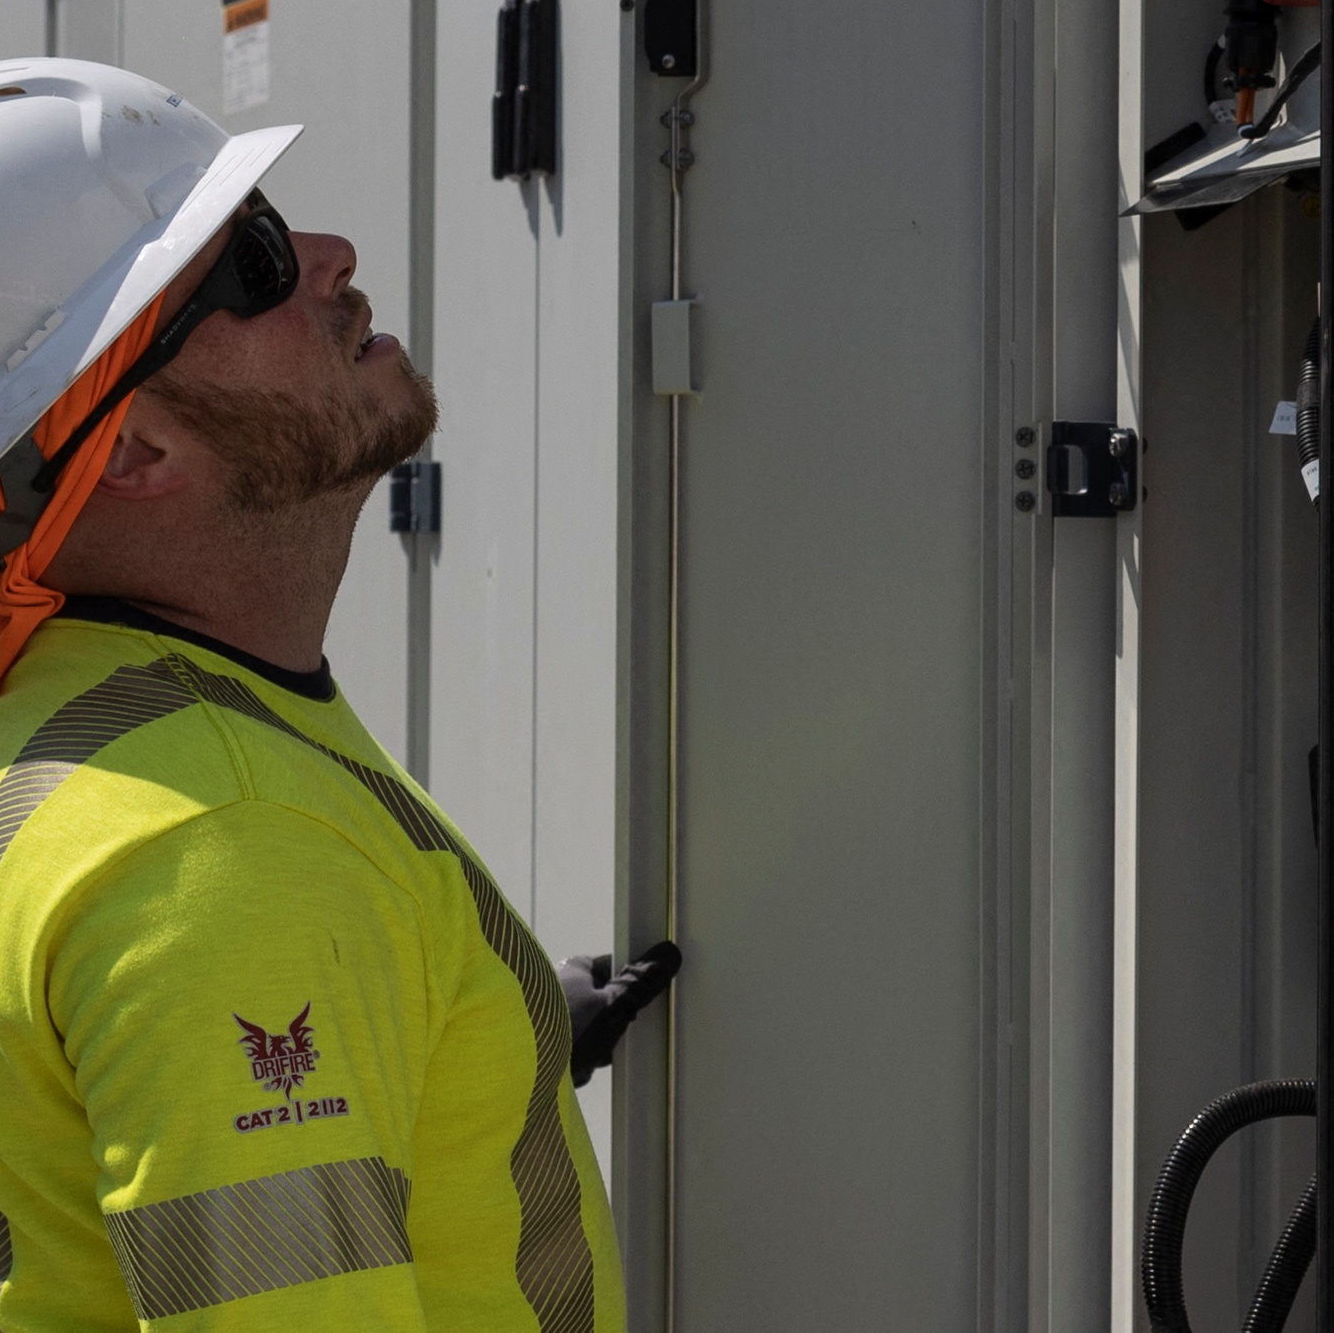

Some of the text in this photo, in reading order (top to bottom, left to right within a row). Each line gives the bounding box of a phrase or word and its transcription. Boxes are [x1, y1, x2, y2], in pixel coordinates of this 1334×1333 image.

[252, 1052, 315, 1081] DRIFIRE
[236, 1098, 348, 1131] CAT 2 2112
